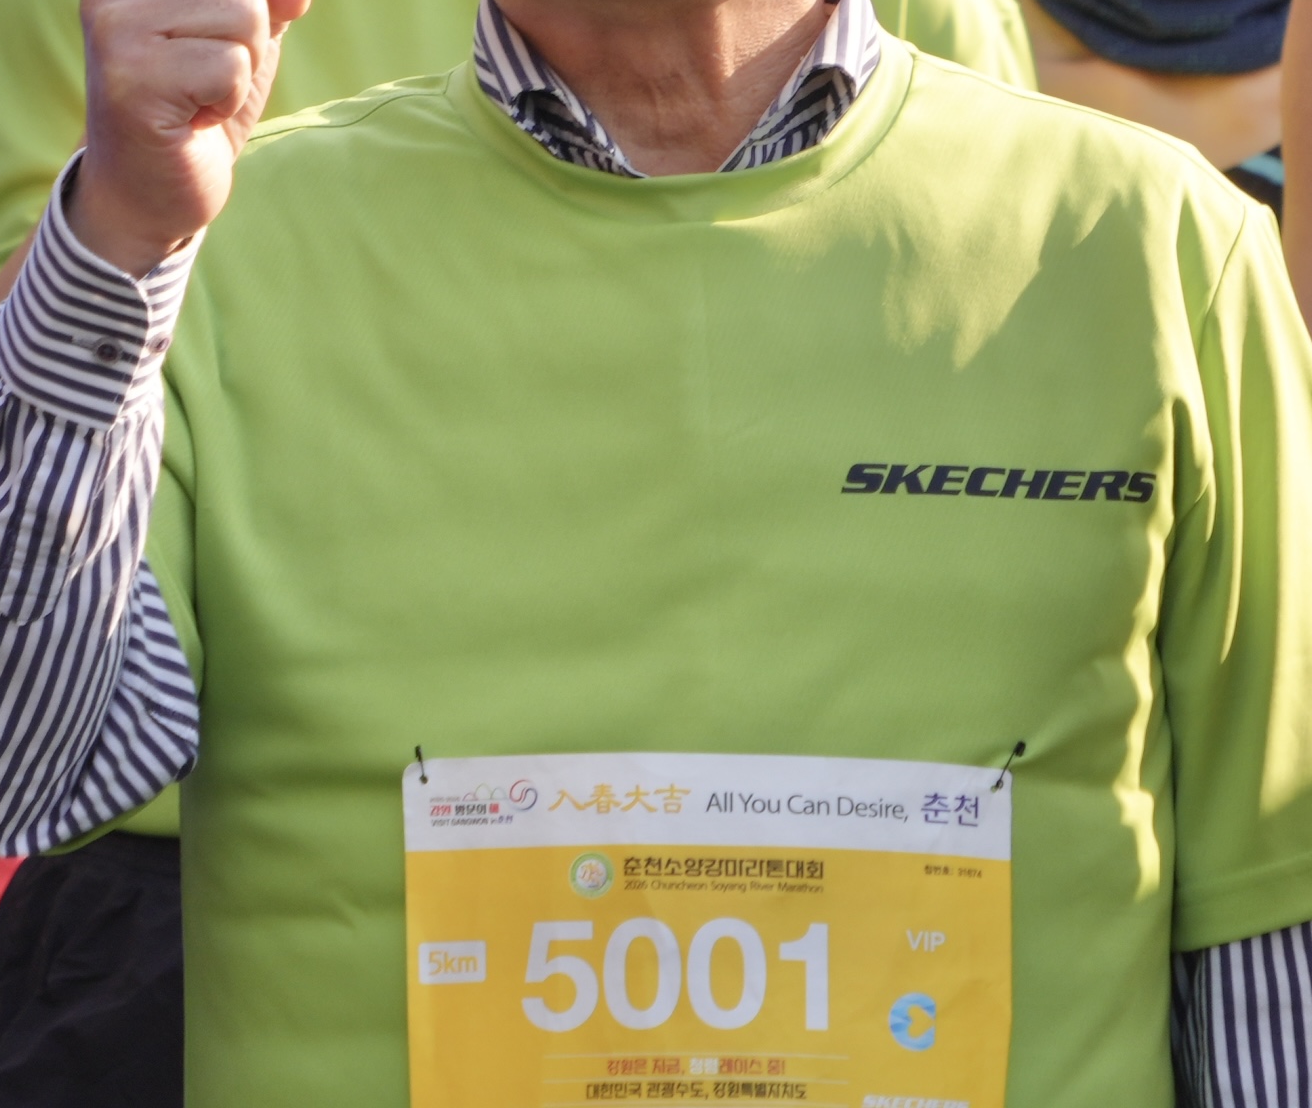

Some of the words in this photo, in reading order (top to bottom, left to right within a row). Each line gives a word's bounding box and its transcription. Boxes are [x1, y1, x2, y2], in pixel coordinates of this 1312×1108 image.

[841, 463, 1157, 503] SKECHERS
[706, 792, 734, 813] All
[739, 793, 780, 814] You
[788, 794, 830, 816] Can
[837, 797, 908, 823] Desire,
[921, 793, 979, 827] 춘천
[906, 928, 946, 952] VIP
[428, 951, 478, 975] 5km
[521, 916, 829, 1033] 5001
[586, 1082, 642, 1100] 대한민국
